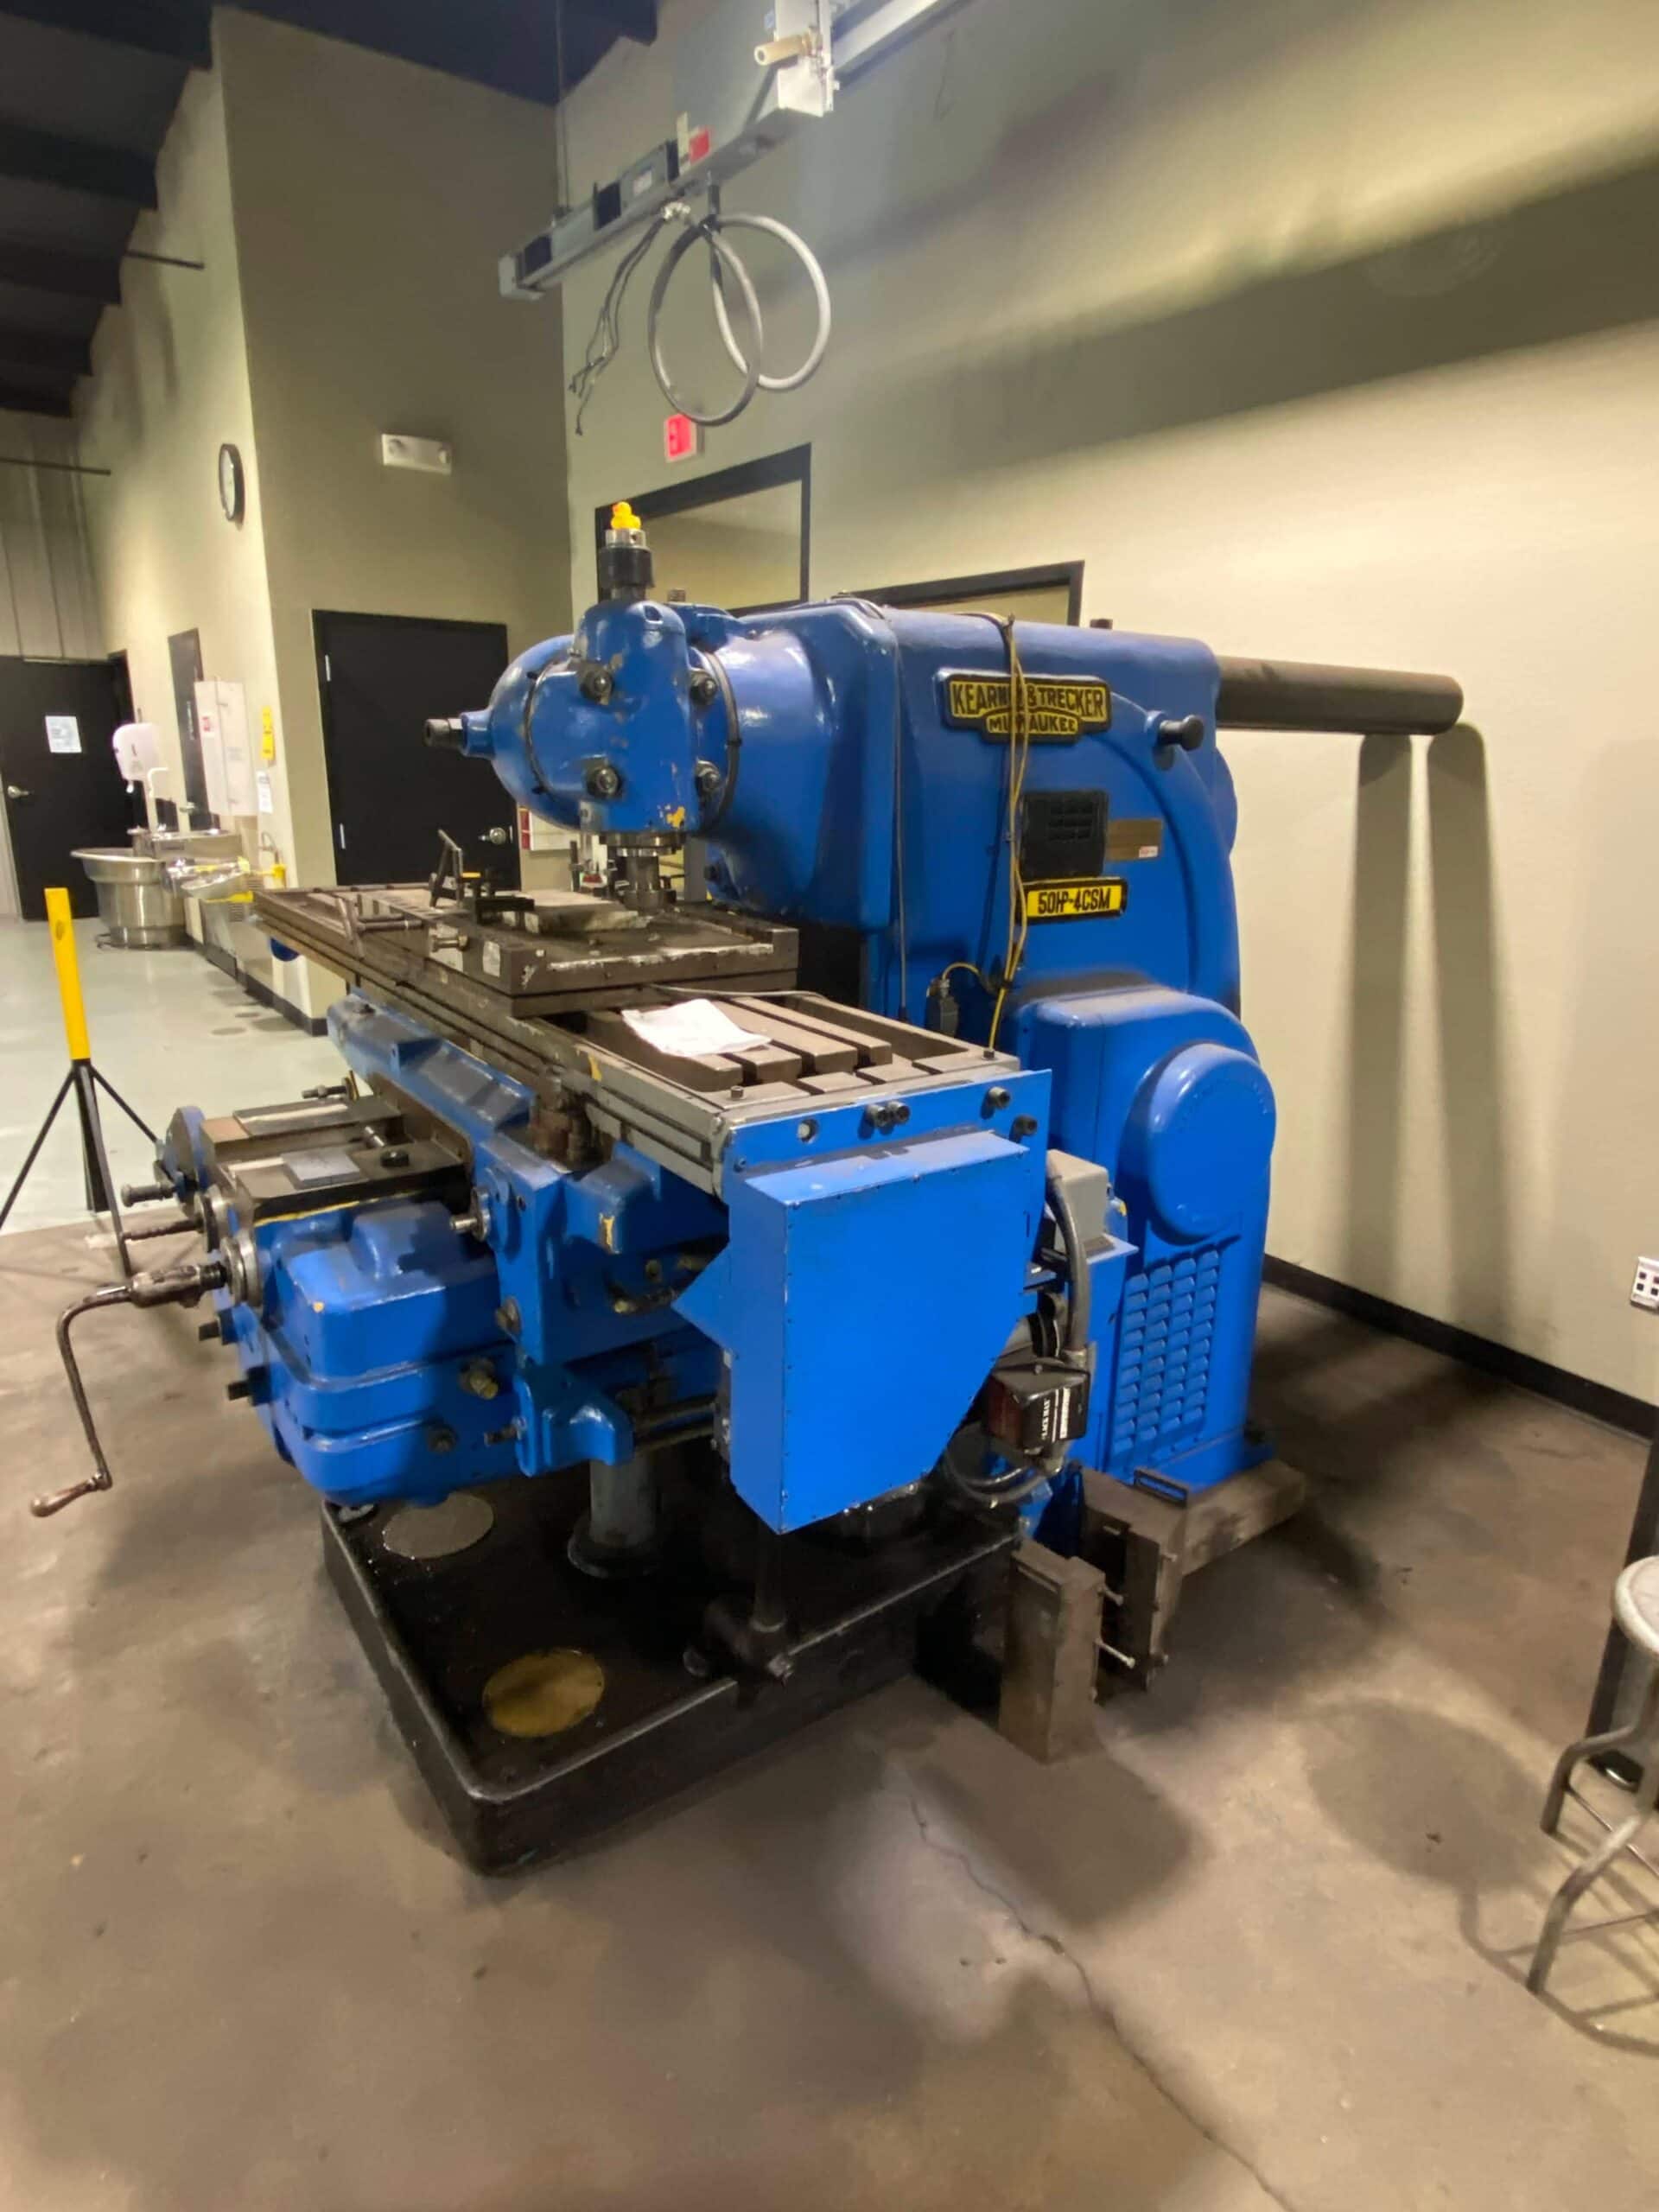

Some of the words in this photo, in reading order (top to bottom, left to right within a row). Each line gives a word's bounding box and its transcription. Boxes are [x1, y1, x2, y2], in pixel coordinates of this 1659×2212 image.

[952, 683, 1024, 715] KEARN
[1027, 684, 1037, 707] &
[1037, 686, 1104, 717] TRECKER
